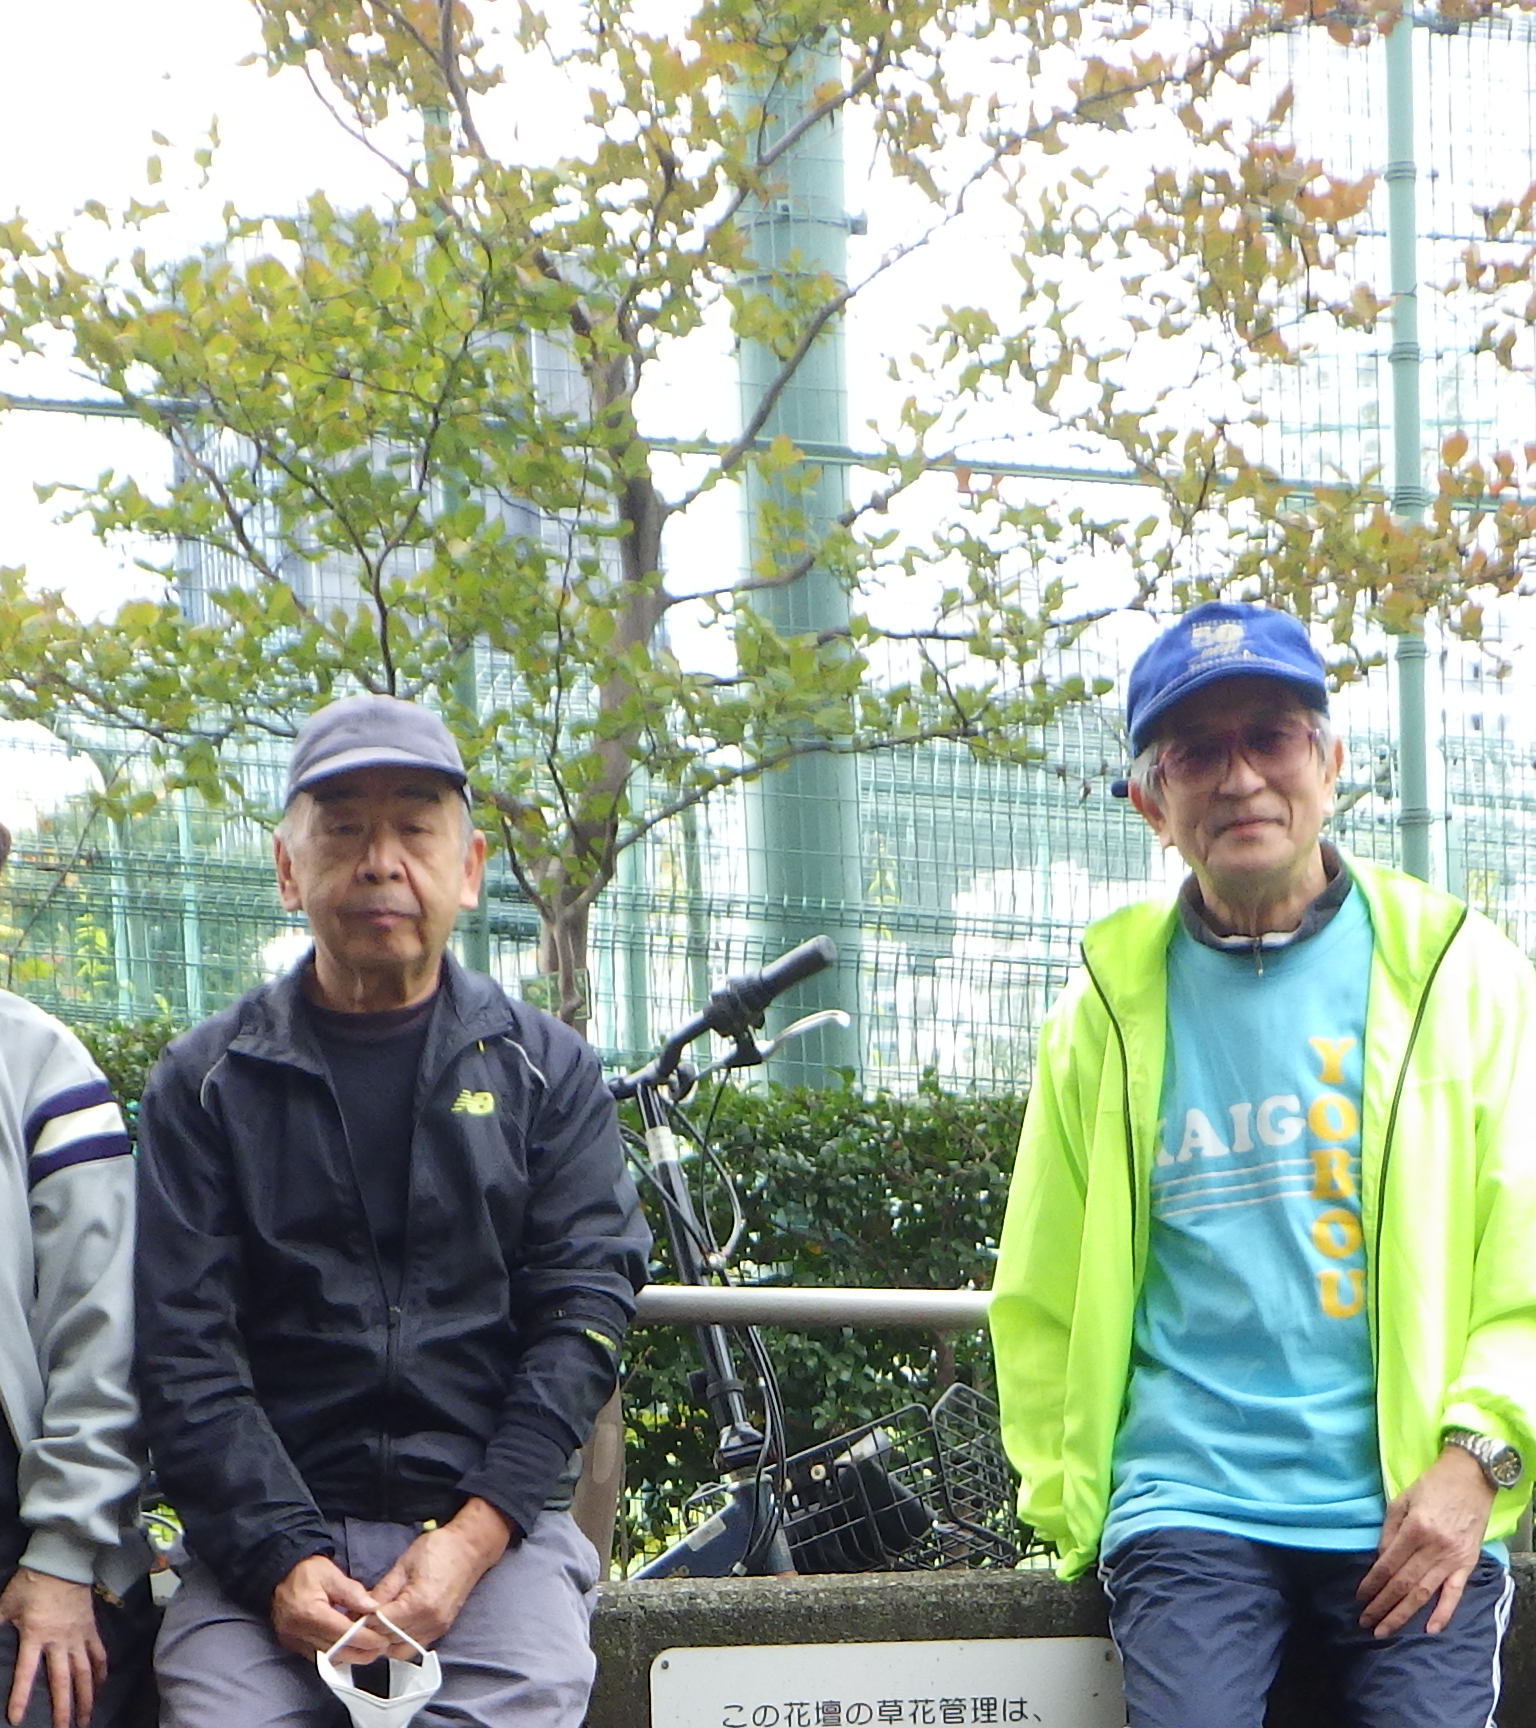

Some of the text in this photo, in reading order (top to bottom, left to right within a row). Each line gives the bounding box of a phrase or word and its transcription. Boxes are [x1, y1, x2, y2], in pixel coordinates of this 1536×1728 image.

[722, 1696, 1043, 1728] この花壇の草花管理は、
